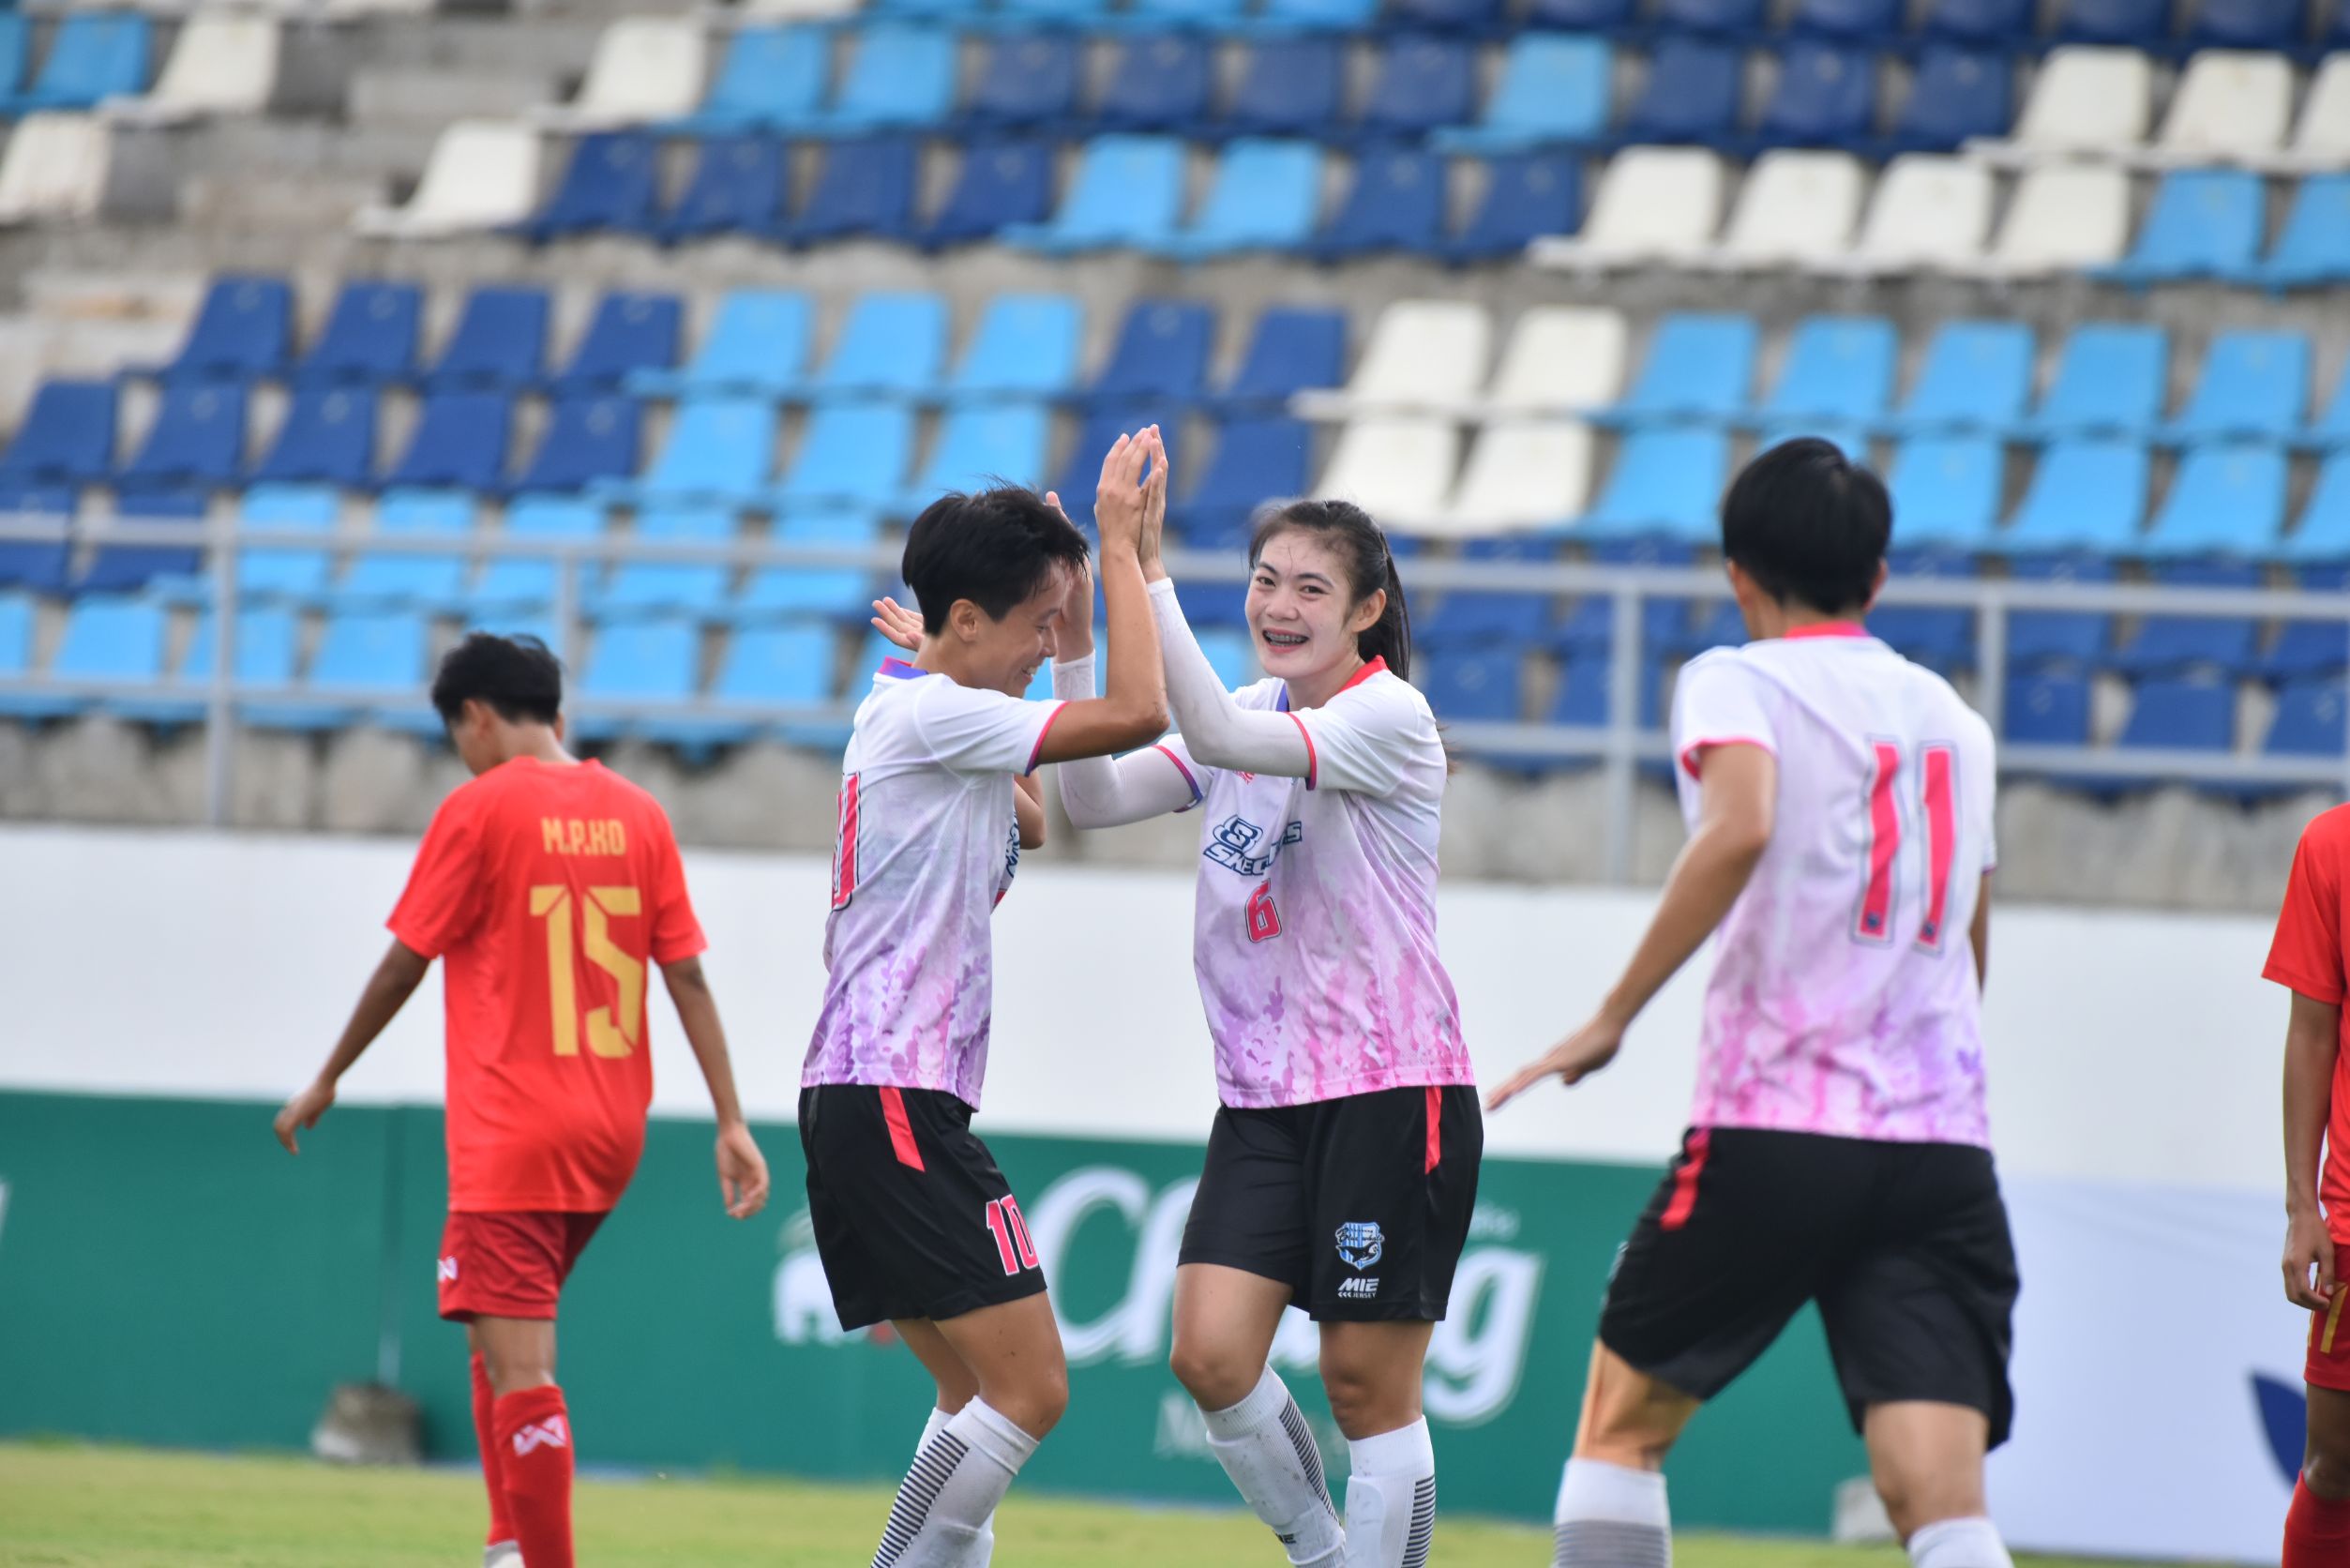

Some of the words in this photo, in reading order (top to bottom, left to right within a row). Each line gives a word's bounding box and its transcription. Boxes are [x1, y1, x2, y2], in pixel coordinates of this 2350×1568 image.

[540, 816, 627, 856] M.P.KO
[1851, 731, 1962, 958] 11
[1244, 878, 1283, 943] 6
[528, 882, 644, 1059] 15
[986, 1193, 1040, 1276] 10
[1338, 1277, 1379, 1292] MIE
